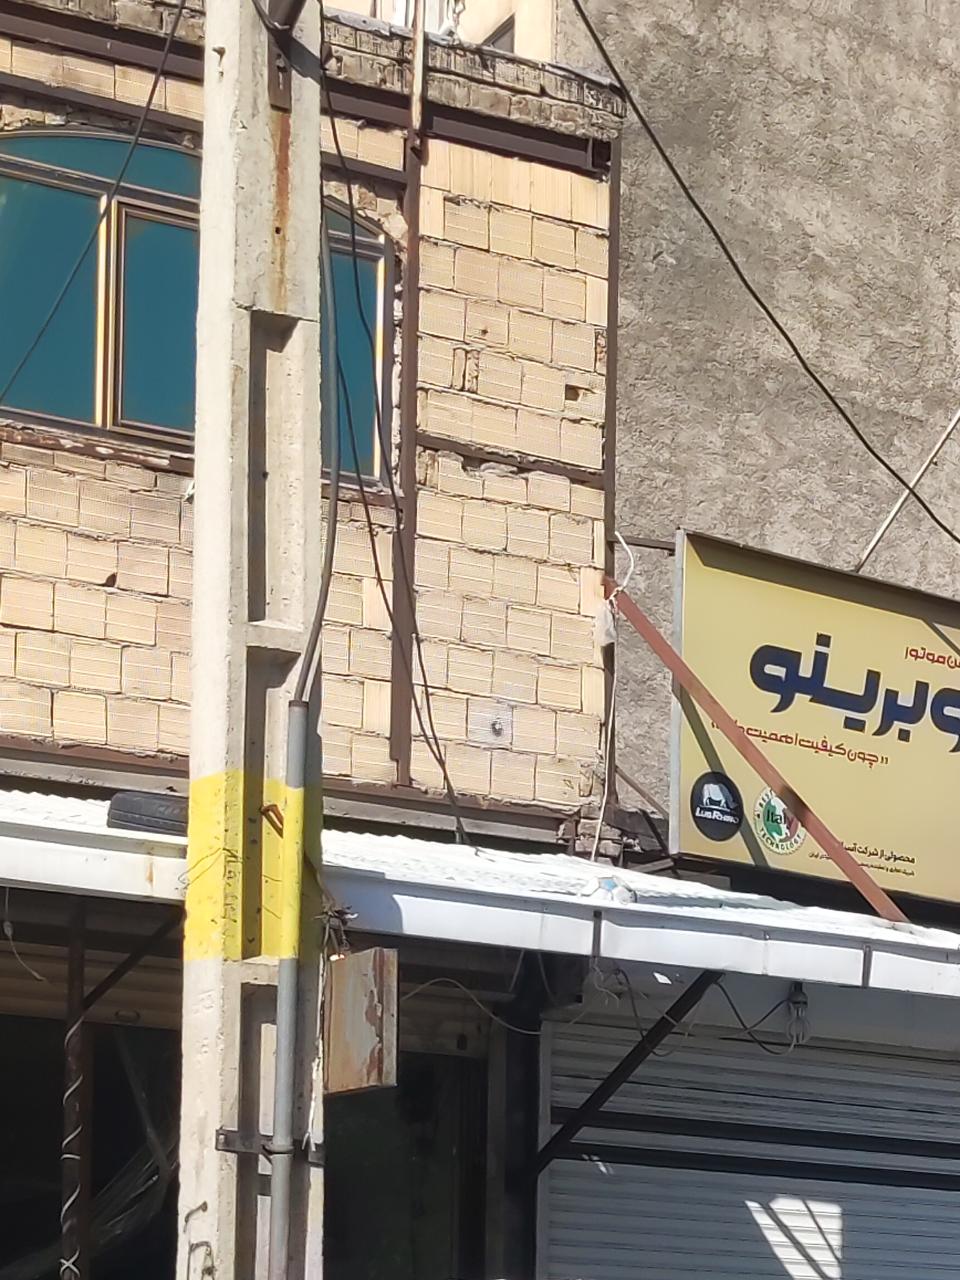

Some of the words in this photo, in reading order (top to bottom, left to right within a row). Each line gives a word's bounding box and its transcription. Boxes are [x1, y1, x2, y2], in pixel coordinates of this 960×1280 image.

[905, 646, 947, 664] موتور
[746, 727, 799, 746] اهمیت
[799, 735, 848, 757] کیفیت
